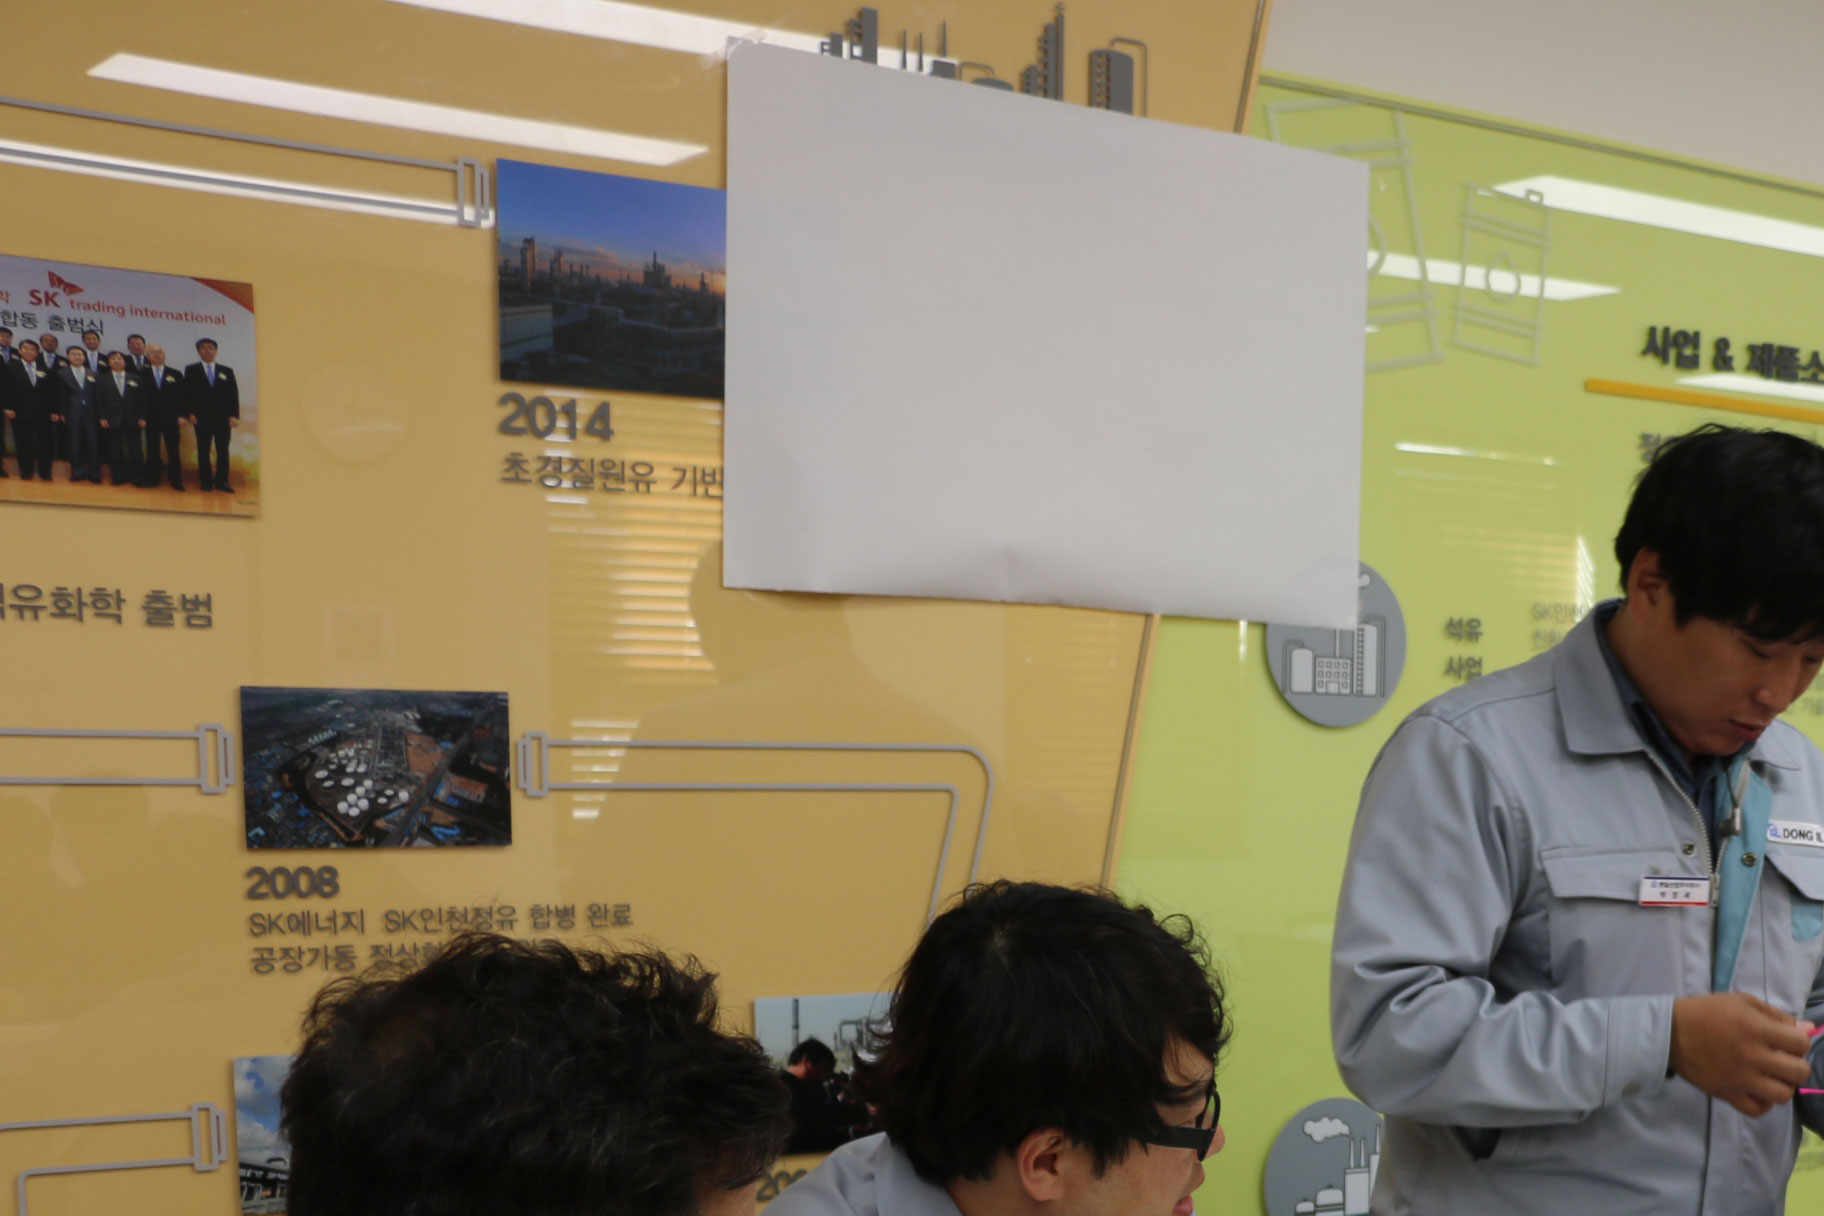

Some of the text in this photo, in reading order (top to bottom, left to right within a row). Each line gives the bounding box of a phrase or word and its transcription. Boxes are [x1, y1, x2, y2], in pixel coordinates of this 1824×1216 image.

[28, 289, 61, 308] SK
[69, 299, 126, 318] trading
[130, 305, 227, 326] international
[1641, 325, 1700, 369] 사업
[1714, 337, 1735, 371] &
[497, 392, 614, 441] 2014
[499, 451, 657, 493] 초경질원유
[0, 583, 212, 628] 유화학 출범
[1444, 617, 1482, 643] 석유
[1783, 828, 1813, 841] DONG
[246, 865, 339, 900] 2008
[248, 903, 634, 937] SK에너지 SK인천정유 합병 완료
[251, 944, 358, 974] 공장가동
